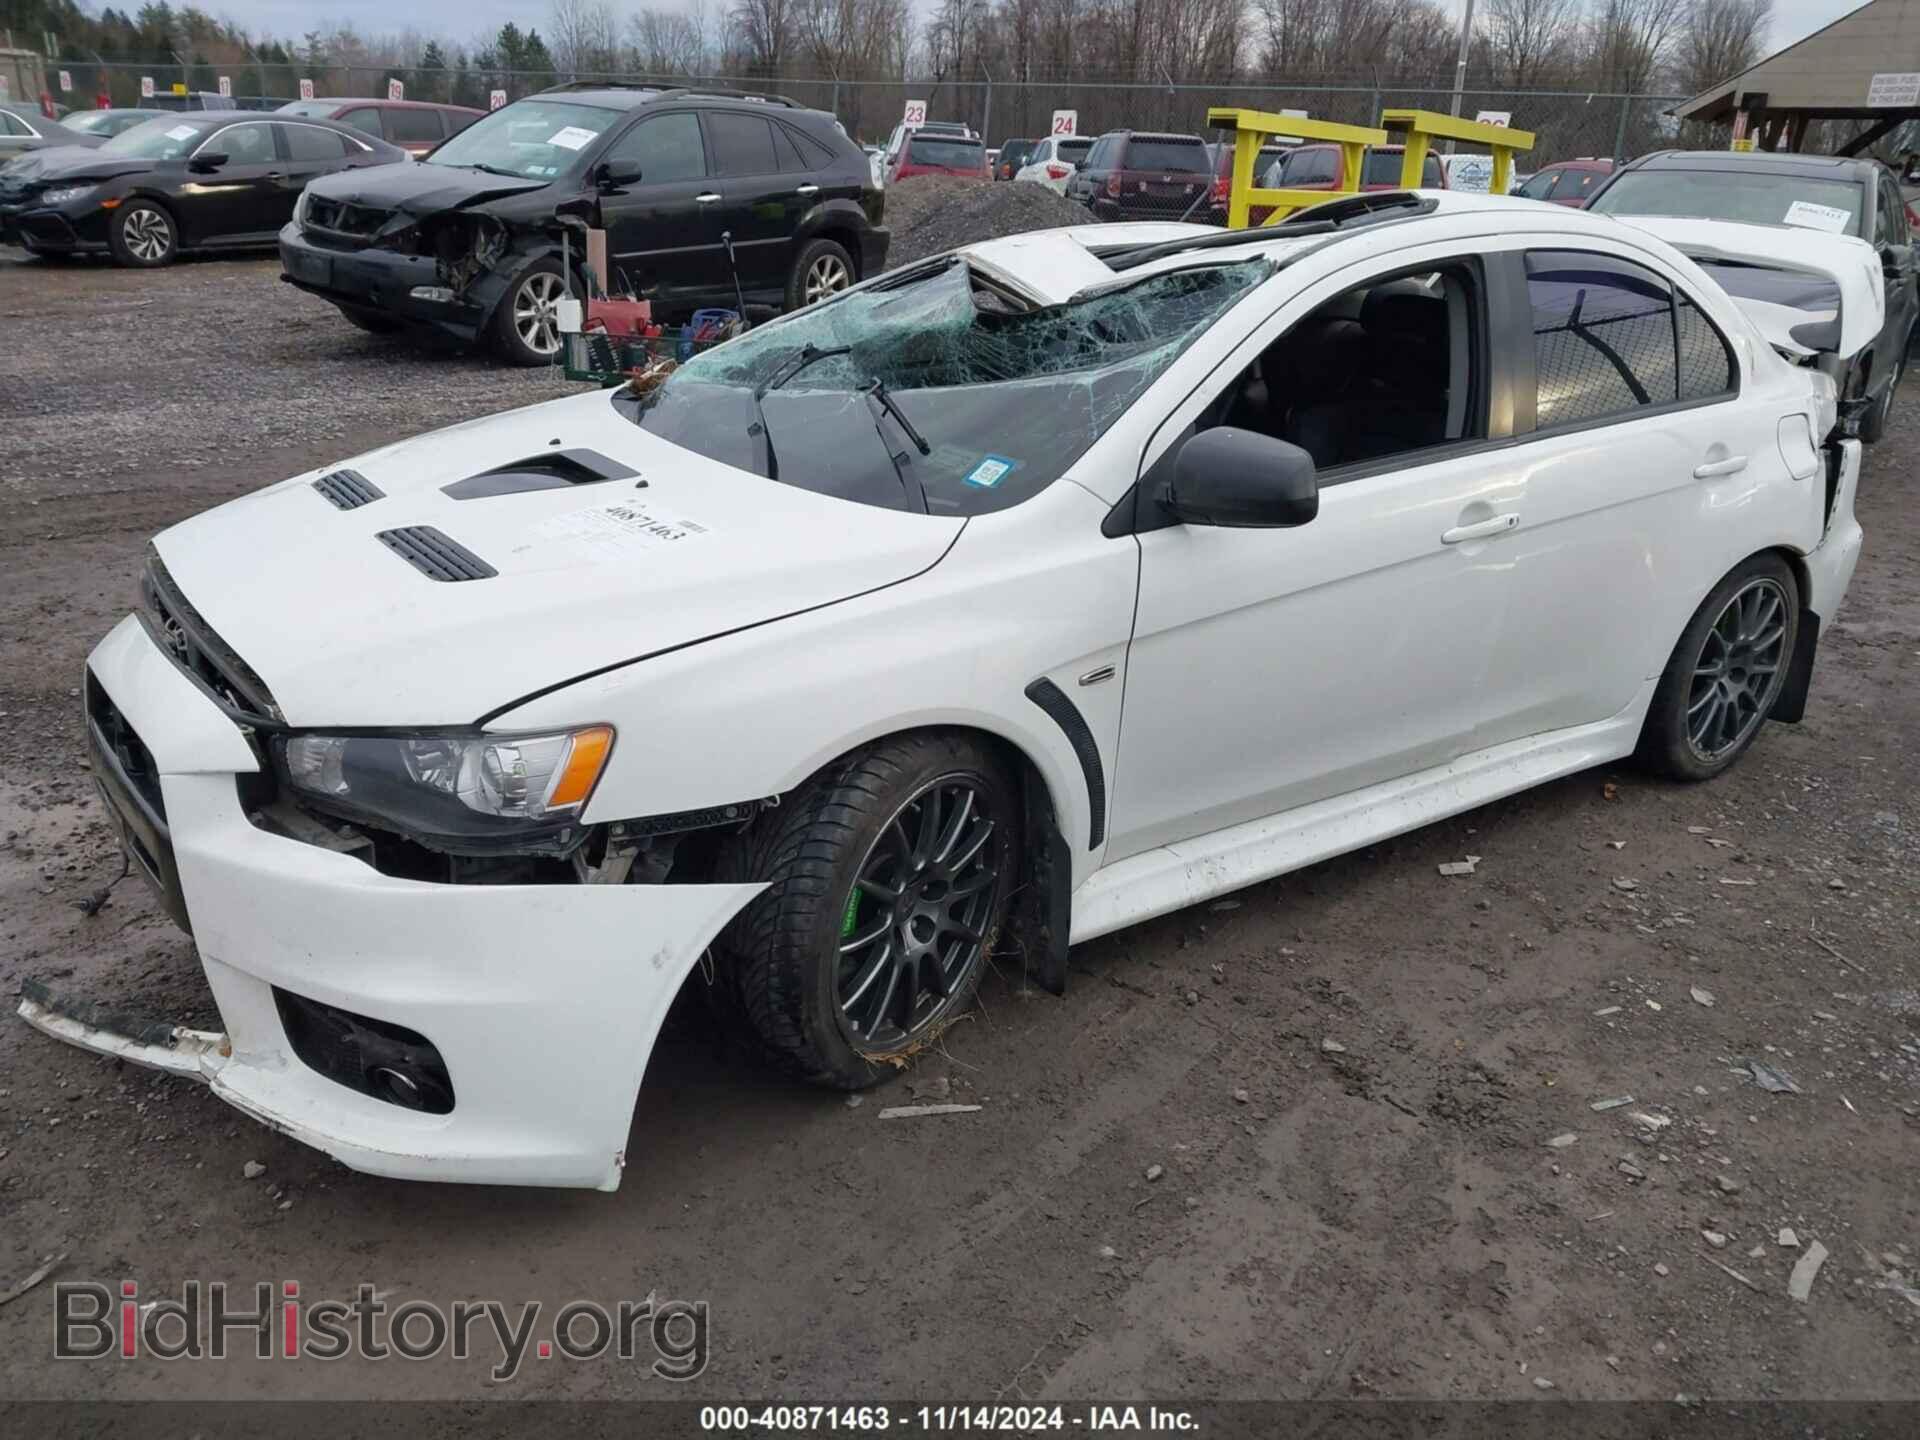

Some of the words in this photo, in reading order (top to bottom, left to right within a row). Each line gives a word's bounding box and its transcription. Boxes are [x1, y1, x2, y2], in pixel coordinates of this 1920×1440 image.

[492, 95, 505, 110] 20
[906, 106, 924, 123] 23
[1054, 117, 1073, 134] 24
